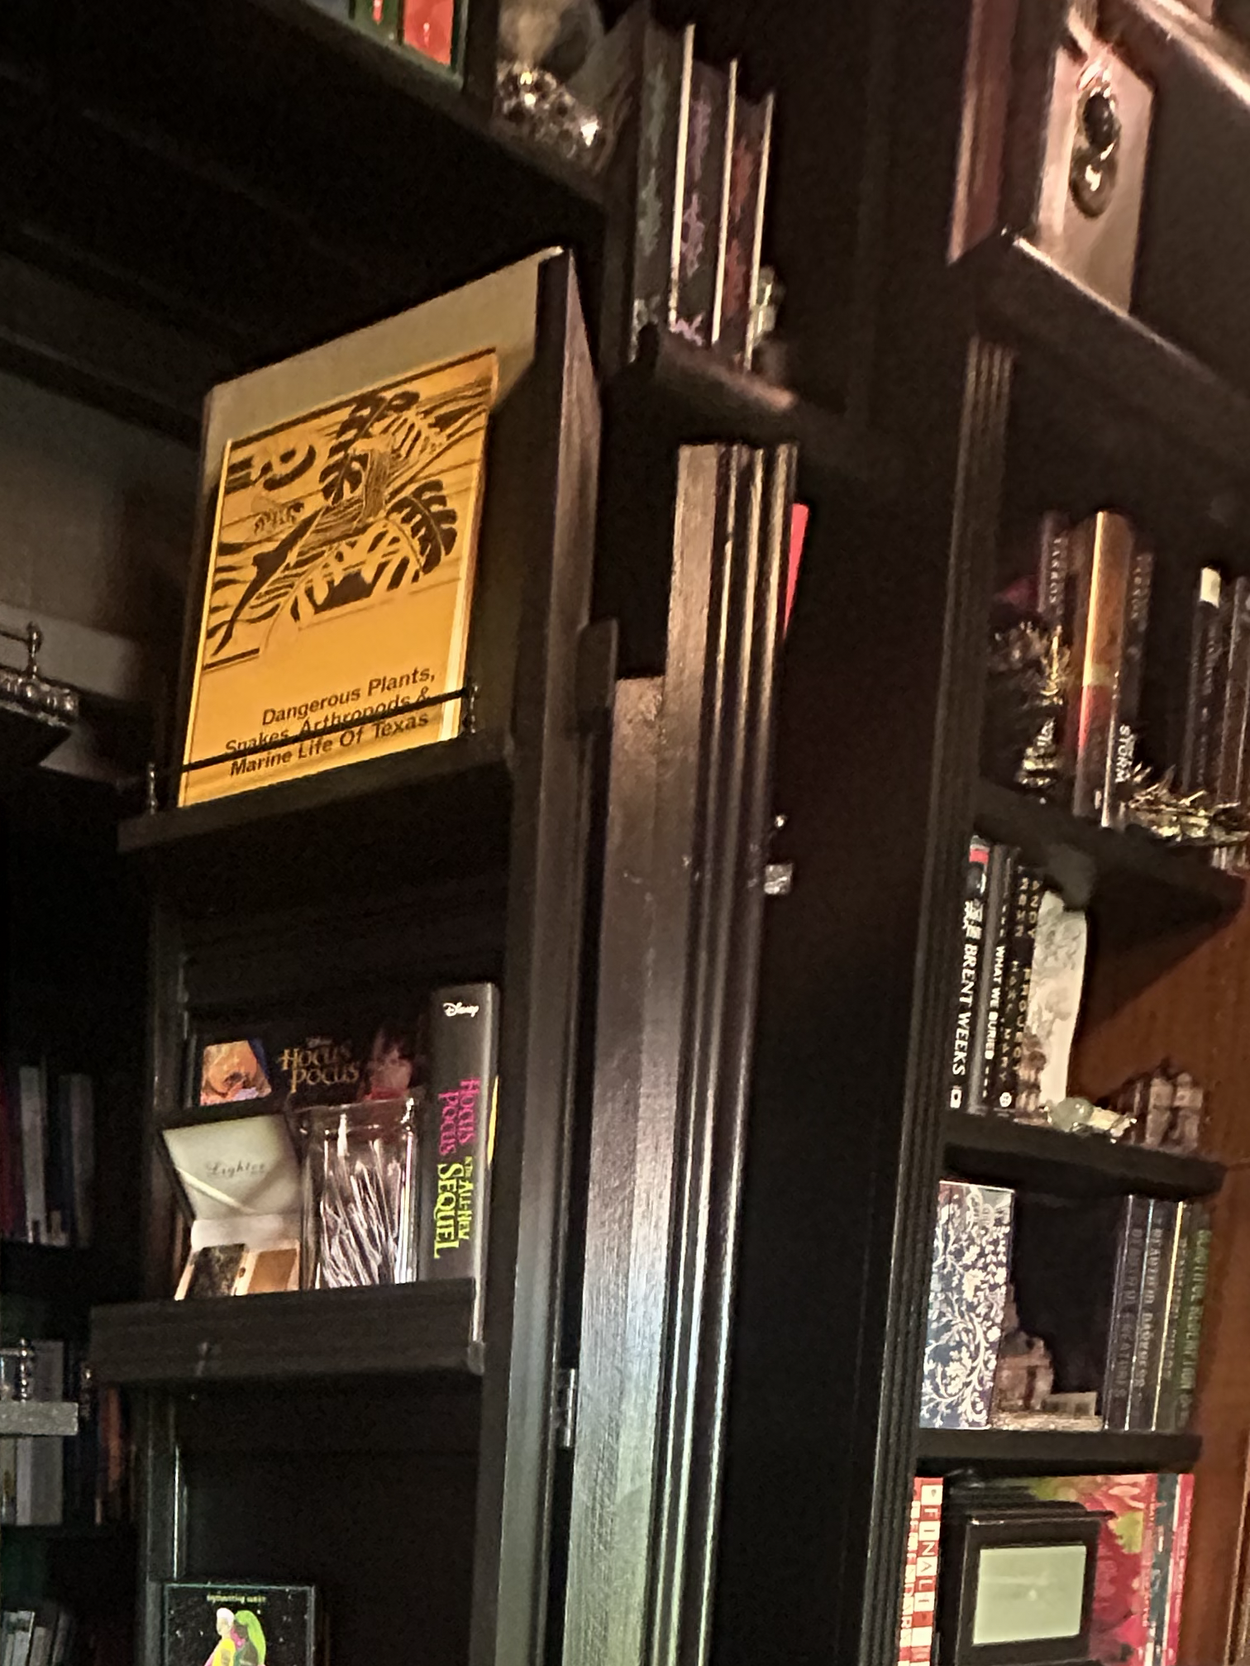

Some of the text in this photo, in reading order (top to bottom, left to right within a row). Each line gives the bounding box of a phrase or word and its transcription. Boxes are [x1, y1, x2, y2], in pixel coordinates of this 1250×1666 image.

[262, 667, 437, 727] Dangerous Plants,
[229, 712, 430, 778] Marine Life Of Texas
[1115, 724, 1134, 784] STORM
[959, 943, 979, 1009] BRENT
[984, 945, 1006, 1060] WHAT WE BURIED
[442, 1001, 480, 1019] Disney
[951, 1012, 972, 1077] WEEKS
[434, 1162, 464, 1260] SEQUEL
